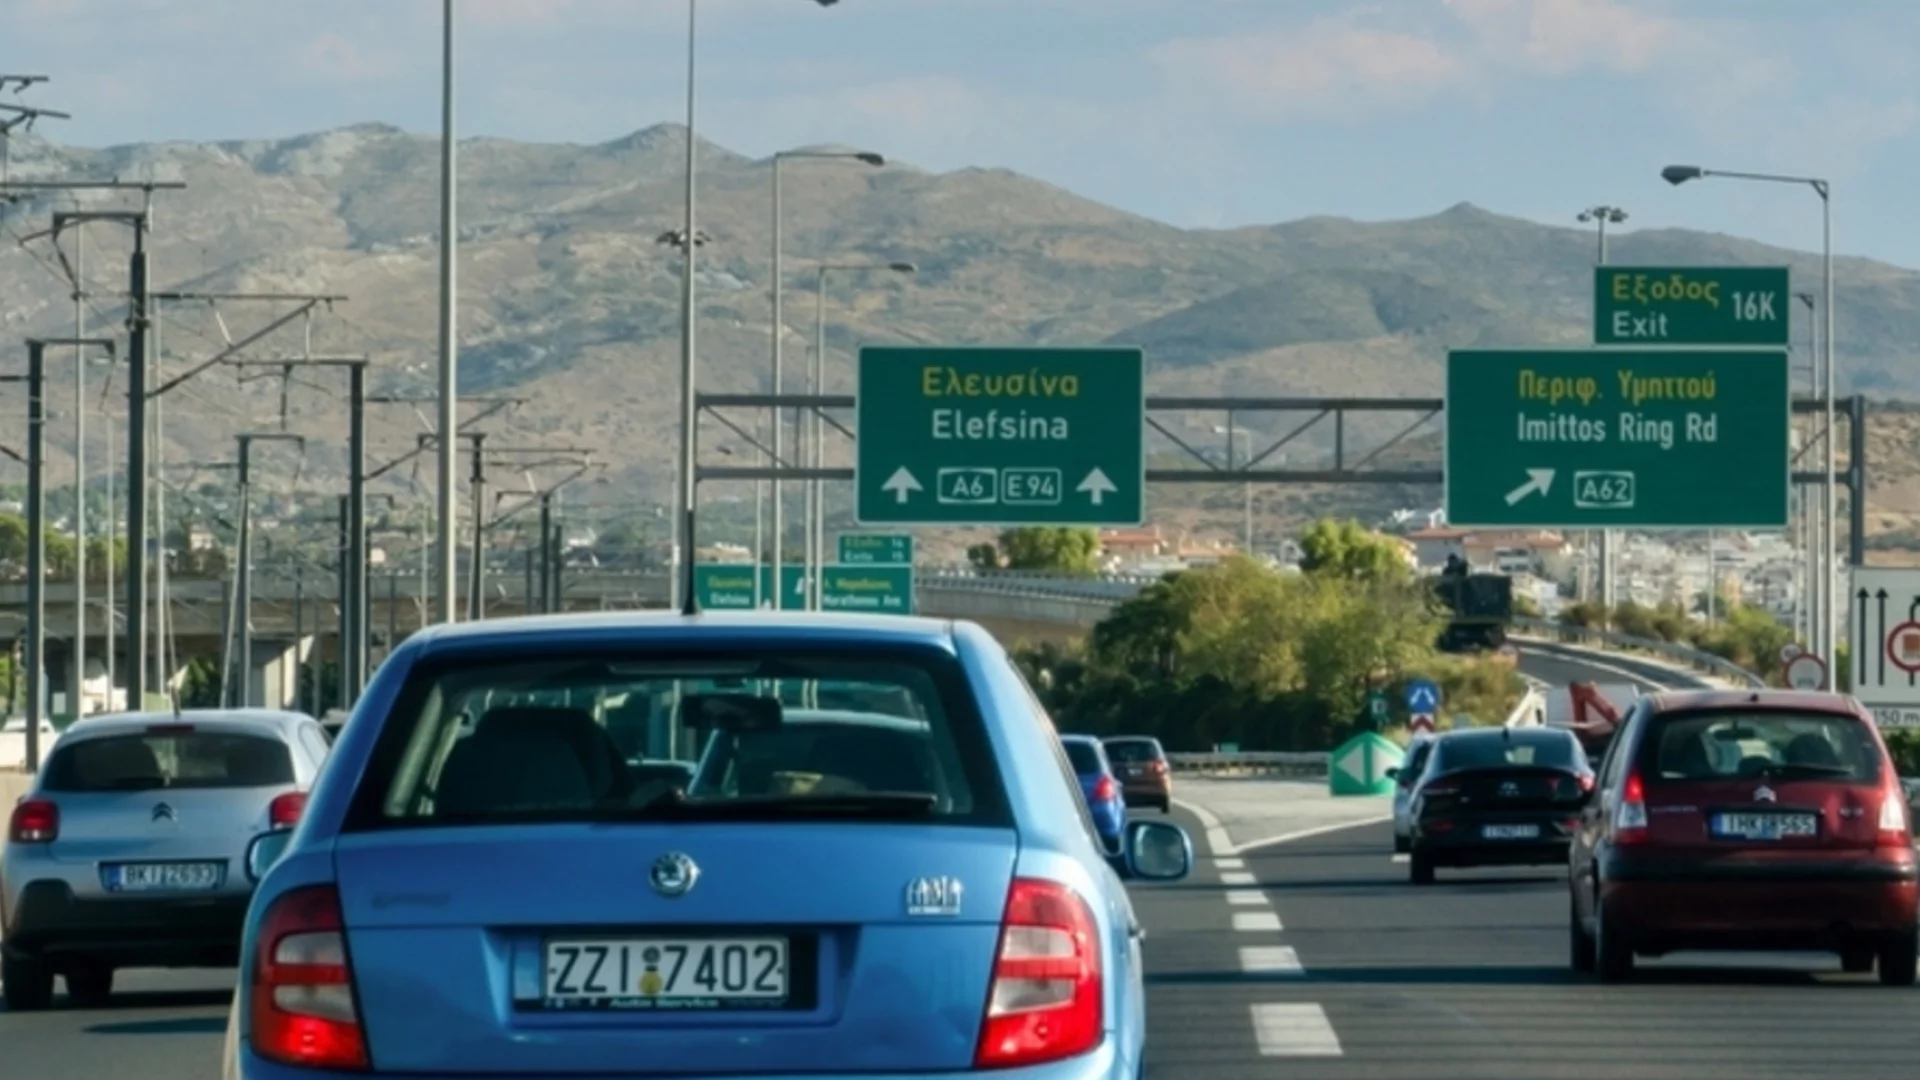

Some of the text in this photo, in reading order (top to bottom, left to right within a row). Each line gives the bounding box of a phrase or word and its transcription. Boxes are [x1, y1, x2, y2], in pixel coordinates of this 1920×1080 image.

[1731, 291, 1777, 321] 16K
[1612, 311, 1669, 337] Exit
[921, 366, 1079, 397] Ελευσίνα
[1518, 369, 1604, 405] Περιφ.
[931, 408, 1069, 440] Elefsina
[1517, 411, 1718, 450] Imittos Ring Rd
[951, 475, 985, 497] A6
[1581, 478, 1629, 501] A62
[553, 944, 779, 994] ZZI 7402
